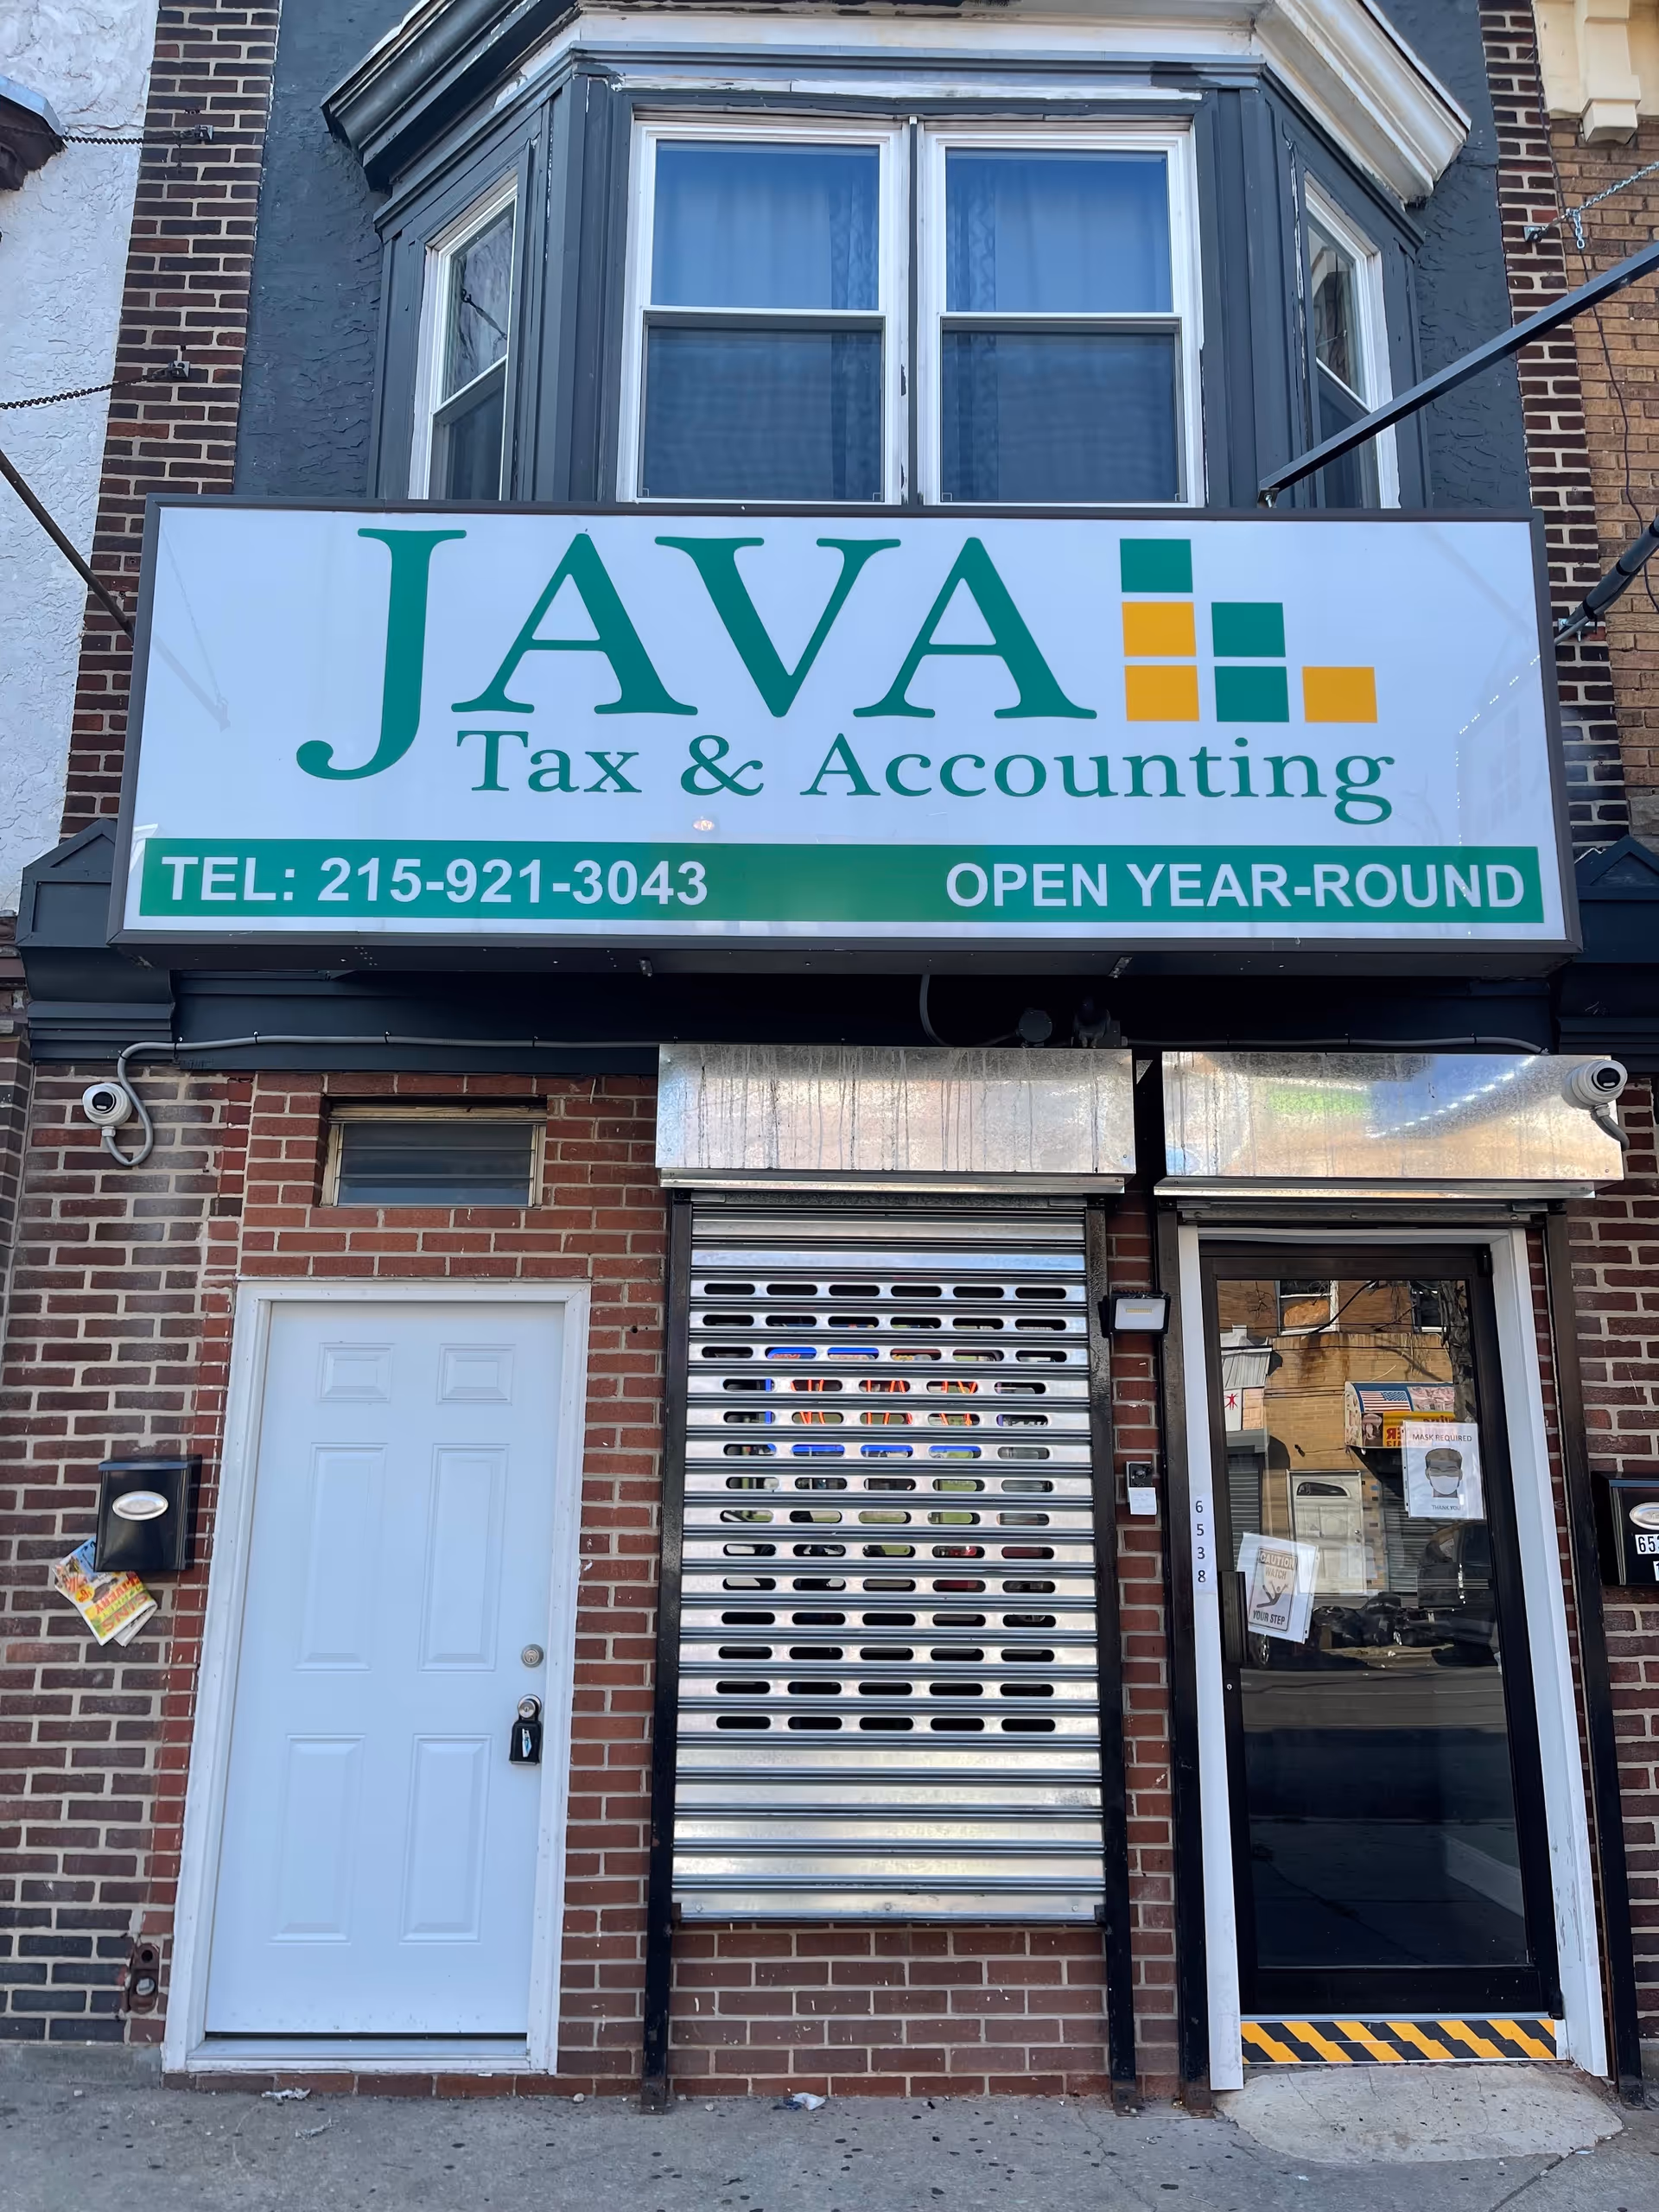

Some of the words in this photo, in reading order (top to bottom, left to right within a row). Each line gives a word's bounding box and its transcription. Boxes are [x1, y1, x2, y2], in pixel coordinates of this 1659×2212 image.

[296, 528, 1096, 780] JAVA
[457, 730, 642, 793] Tax
[681, 734, 764, 797] &
[800, 733, 1395, 824] Accounting
[162, 857, 295, 901] TEL:
[318, 858, 708, 906] 215-921-3043
[946, 863, 1108, 907] OPEN
[1128, 863, 1526, 908] YEAR-ROUND
[1260, 1553, 1295, 1570] CAUTION
[1265, 1567, 1287, 1580] WATCH
[1253, 1610, 1268, 1622] YOUR
[1270, 1613, 1285, 1625] STEP
